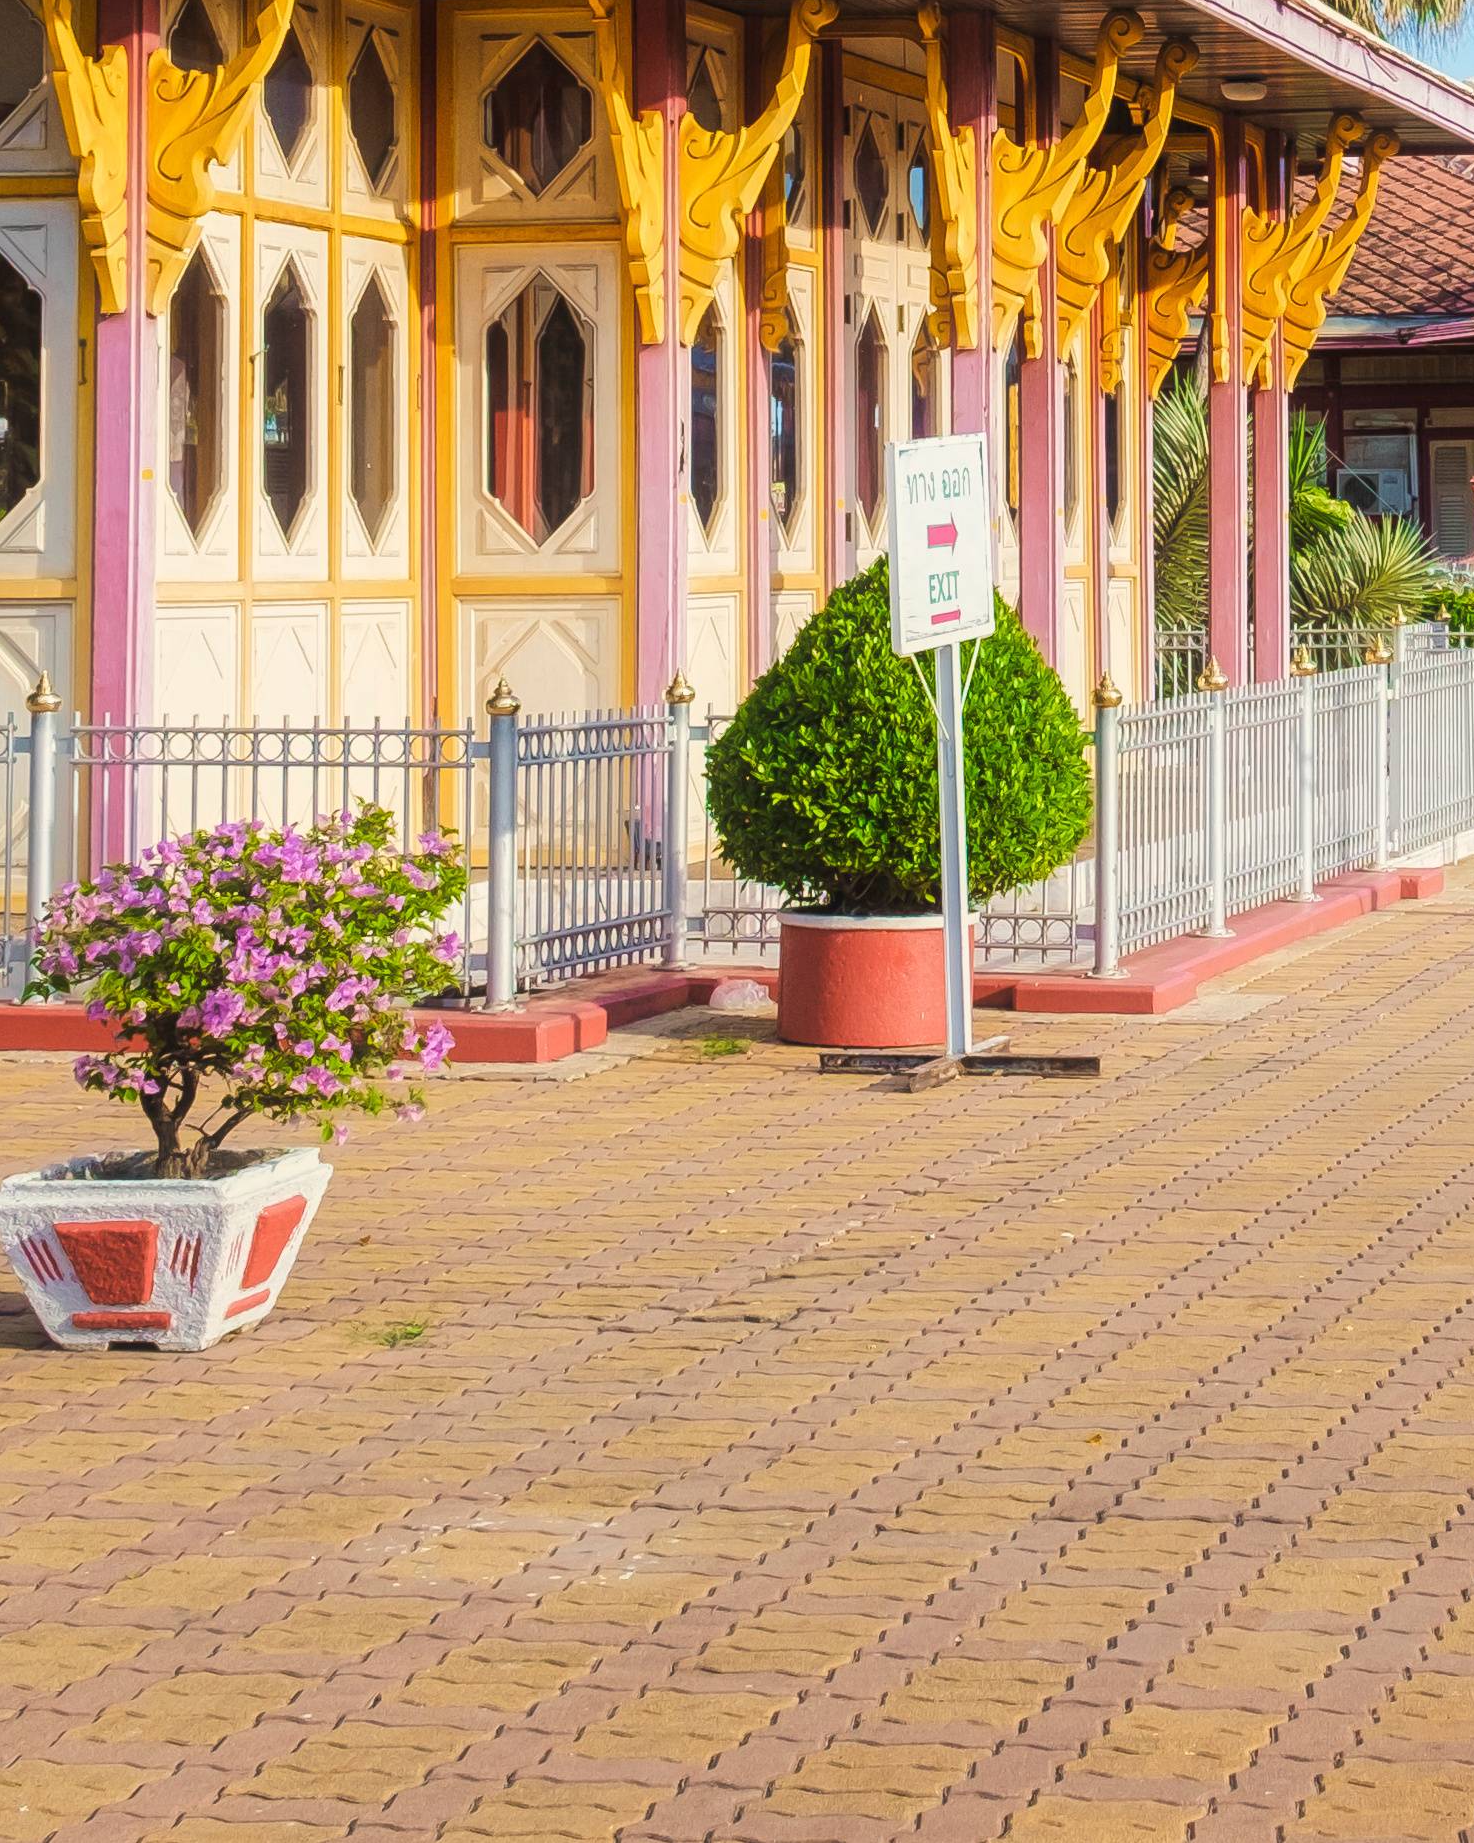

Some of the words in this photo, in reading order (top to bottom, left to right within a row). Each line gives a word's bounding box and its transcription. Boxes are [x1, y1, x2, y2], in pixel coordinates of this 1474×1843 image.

[907, 471, 936, 504] ทาง
[942, 467, 971, 498] ออก
[929, 570, 960, 604] EXIT
